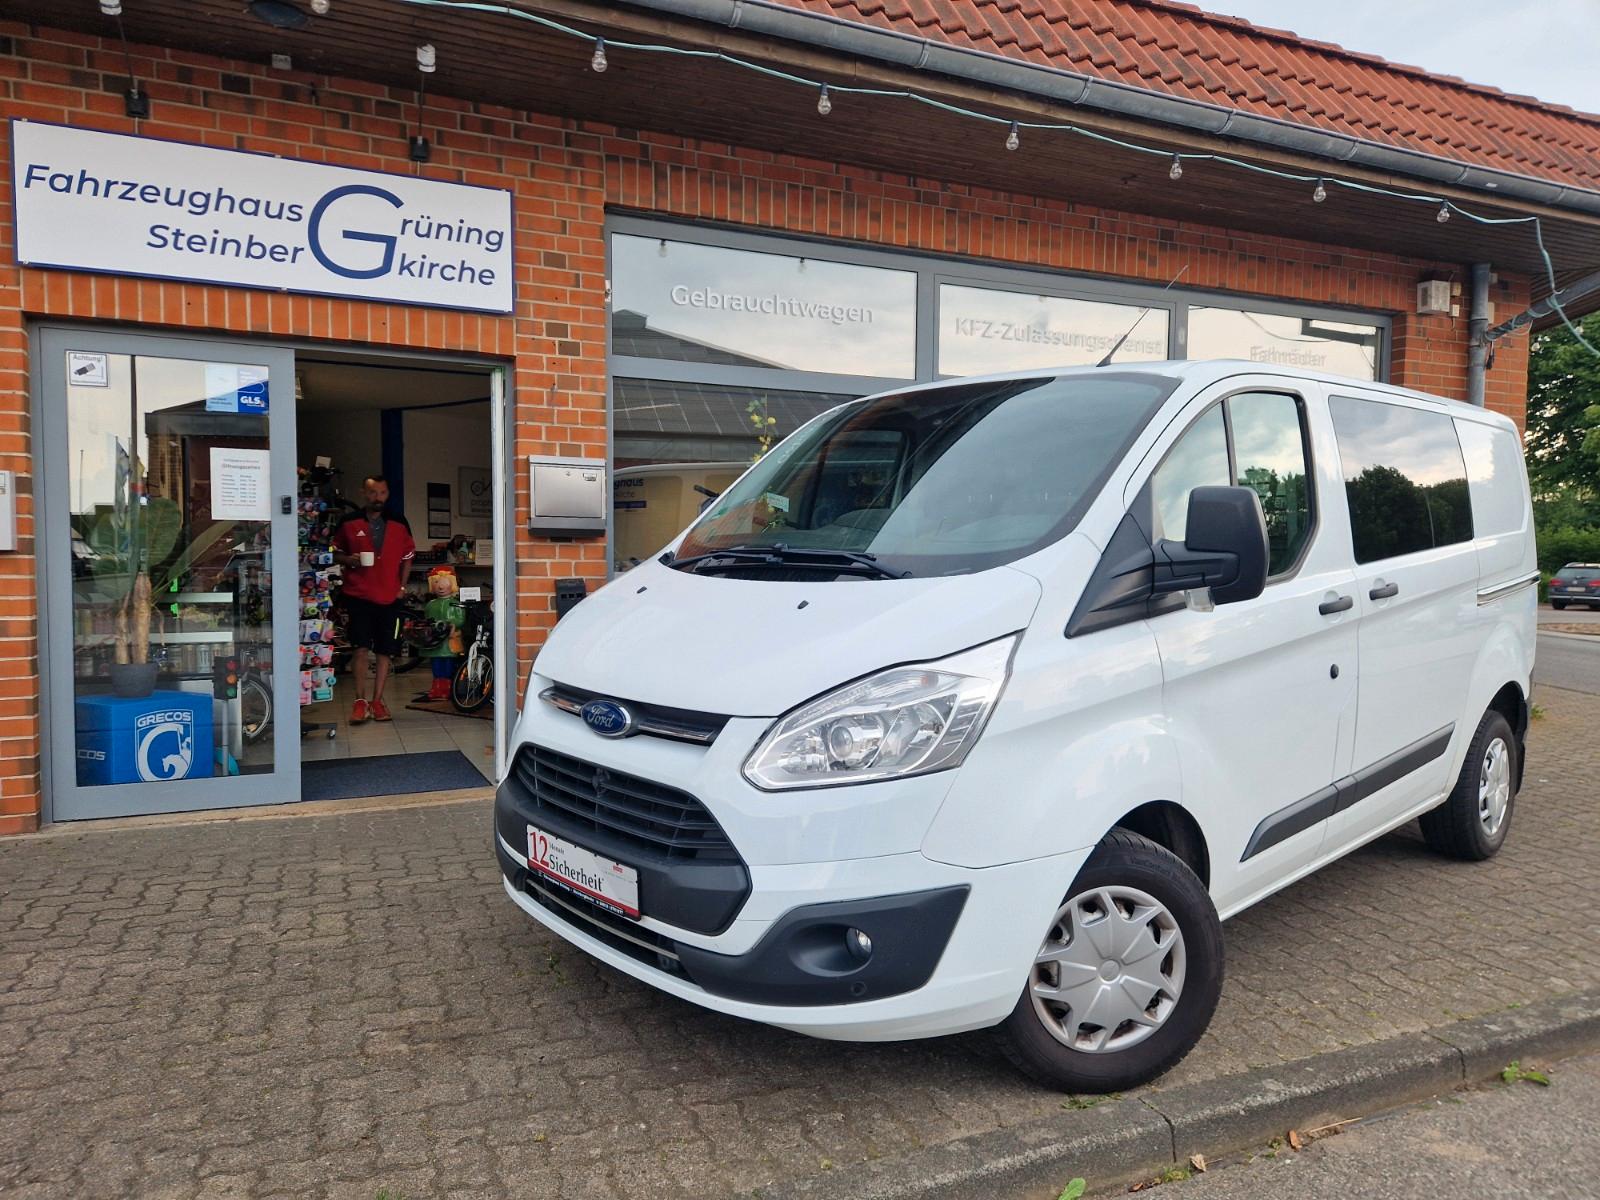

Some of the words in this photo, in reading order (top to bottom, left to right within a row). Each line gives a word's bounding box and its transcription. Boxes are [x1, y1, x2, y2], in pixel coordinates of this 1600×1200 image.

[23, 164, 304, 223] Fahrzeughaus
[670, 284, 874, 325] Gebrauchtwagen
[240, 395, 261, 405] GLS
[137, 711, 192, 728] GRECOS
[587, 704, 614, 729] Ford
[77, 749, 107, 761] COS
[529, 831, 550, 868] 12
[549, 854, 603, 892] Sicherheit
